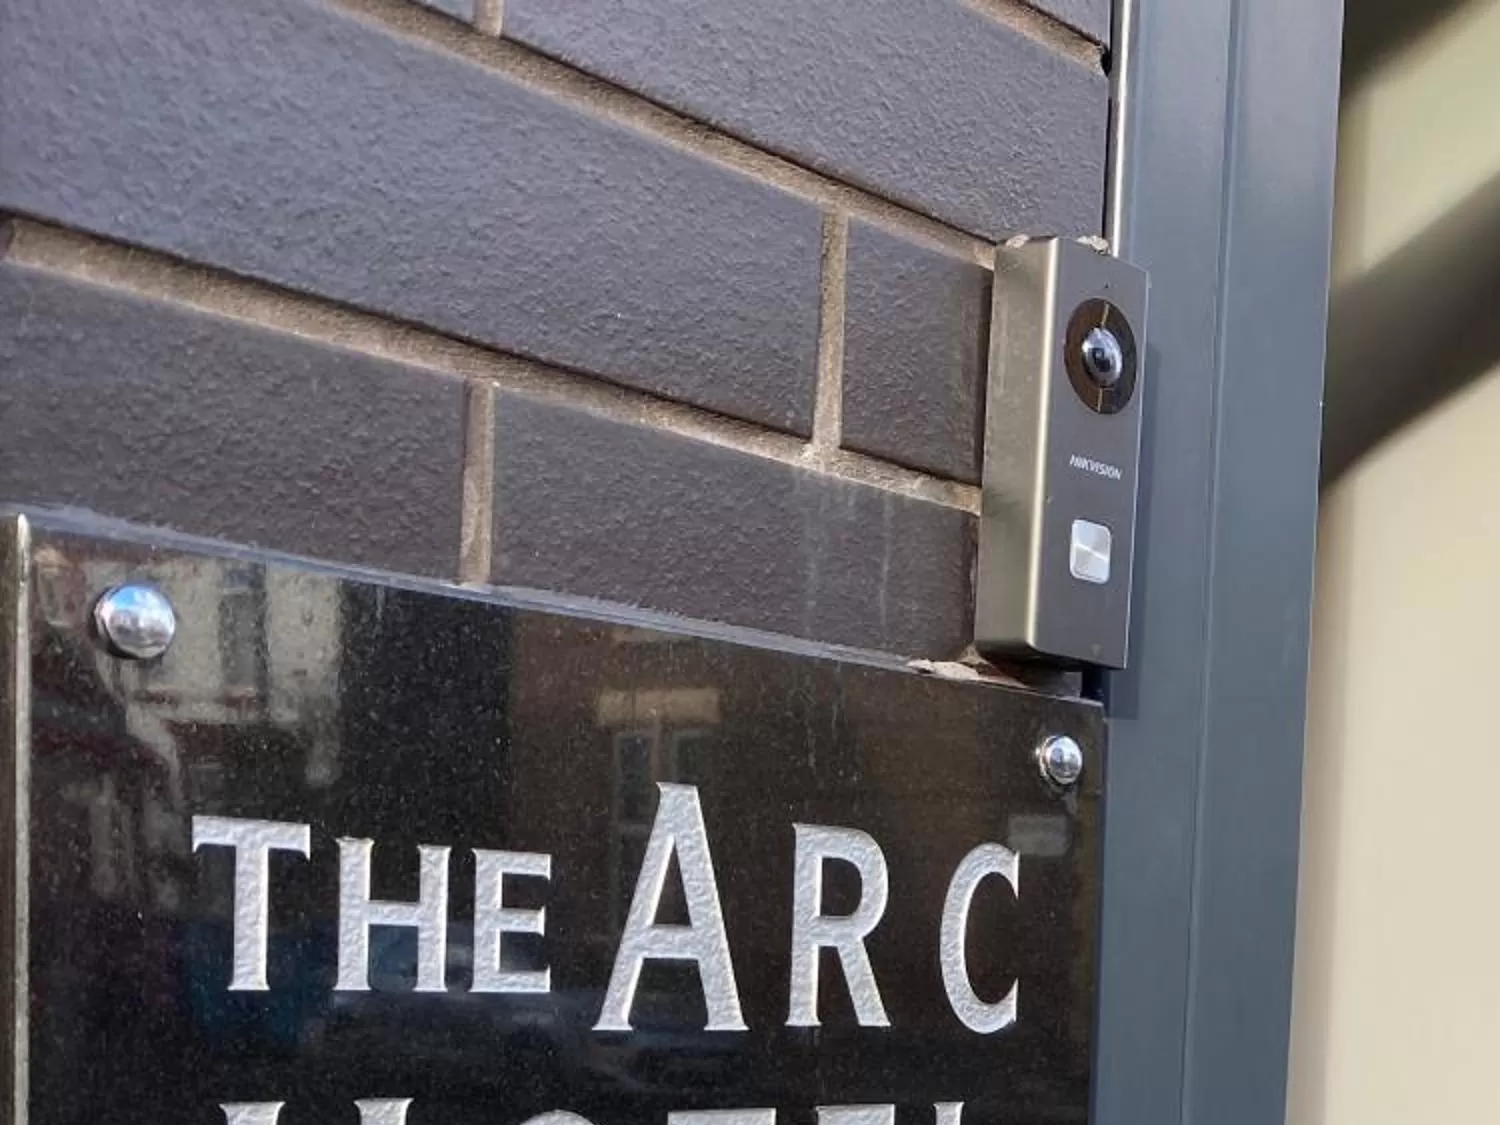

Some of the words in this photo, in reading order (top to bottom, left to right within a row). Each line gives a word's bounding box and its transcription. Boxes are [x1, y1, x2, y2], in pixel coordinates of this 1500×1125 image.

[1069, 454, 1123, 480] HIKVISION
[192, 815, 551, 993] THE
[592, 782, 1021, 1034] ARC
